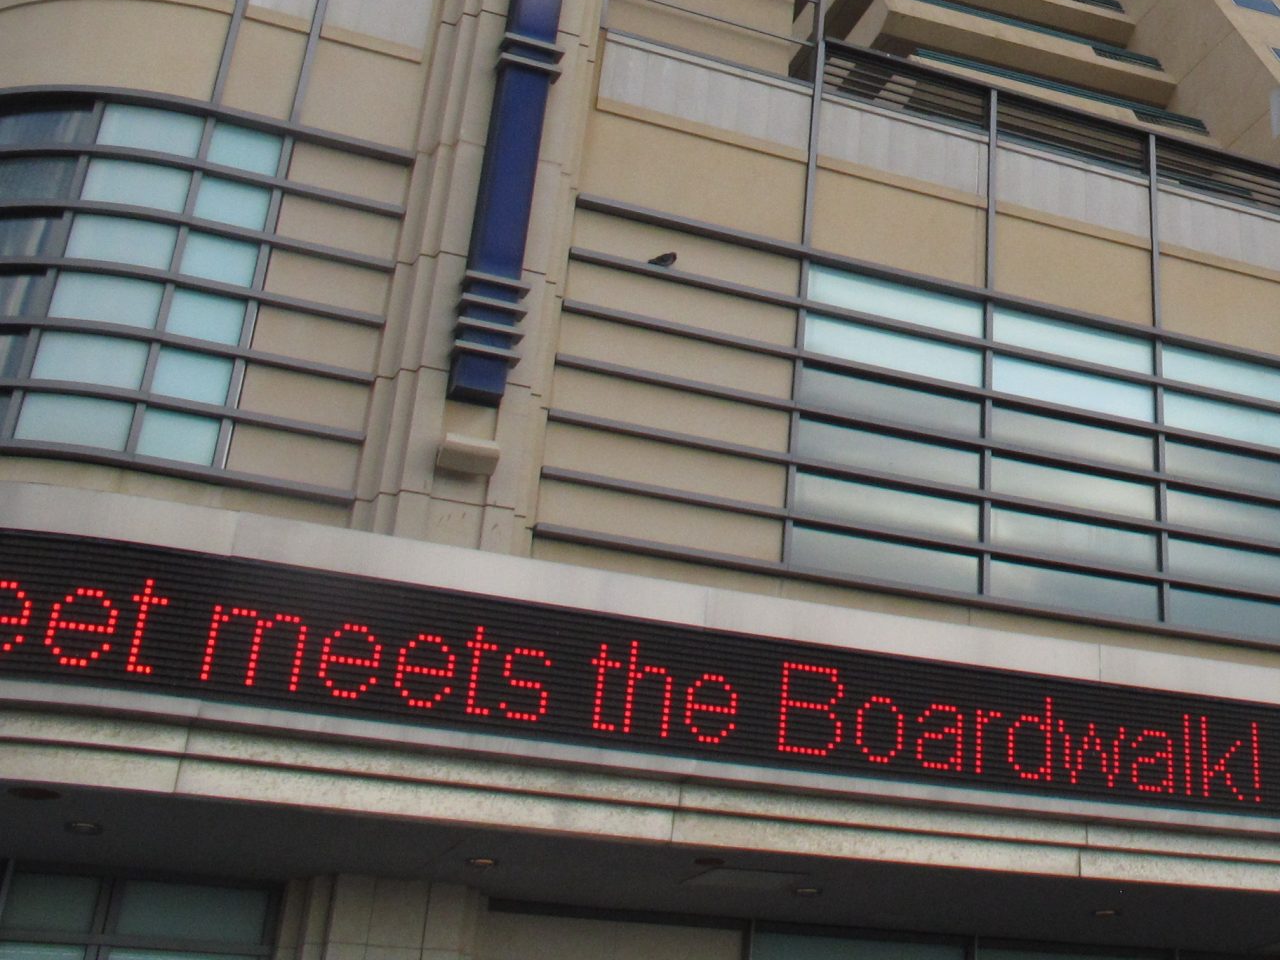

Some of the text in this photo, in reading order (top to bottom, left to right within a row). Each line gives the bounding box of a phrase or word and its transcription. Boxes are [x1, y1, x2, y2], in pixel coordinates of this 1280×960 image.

[197, 604, 554, 722] meets
[589, 639, 741, 744] the
[775, 660, 1263, 803] Boardwalk!
